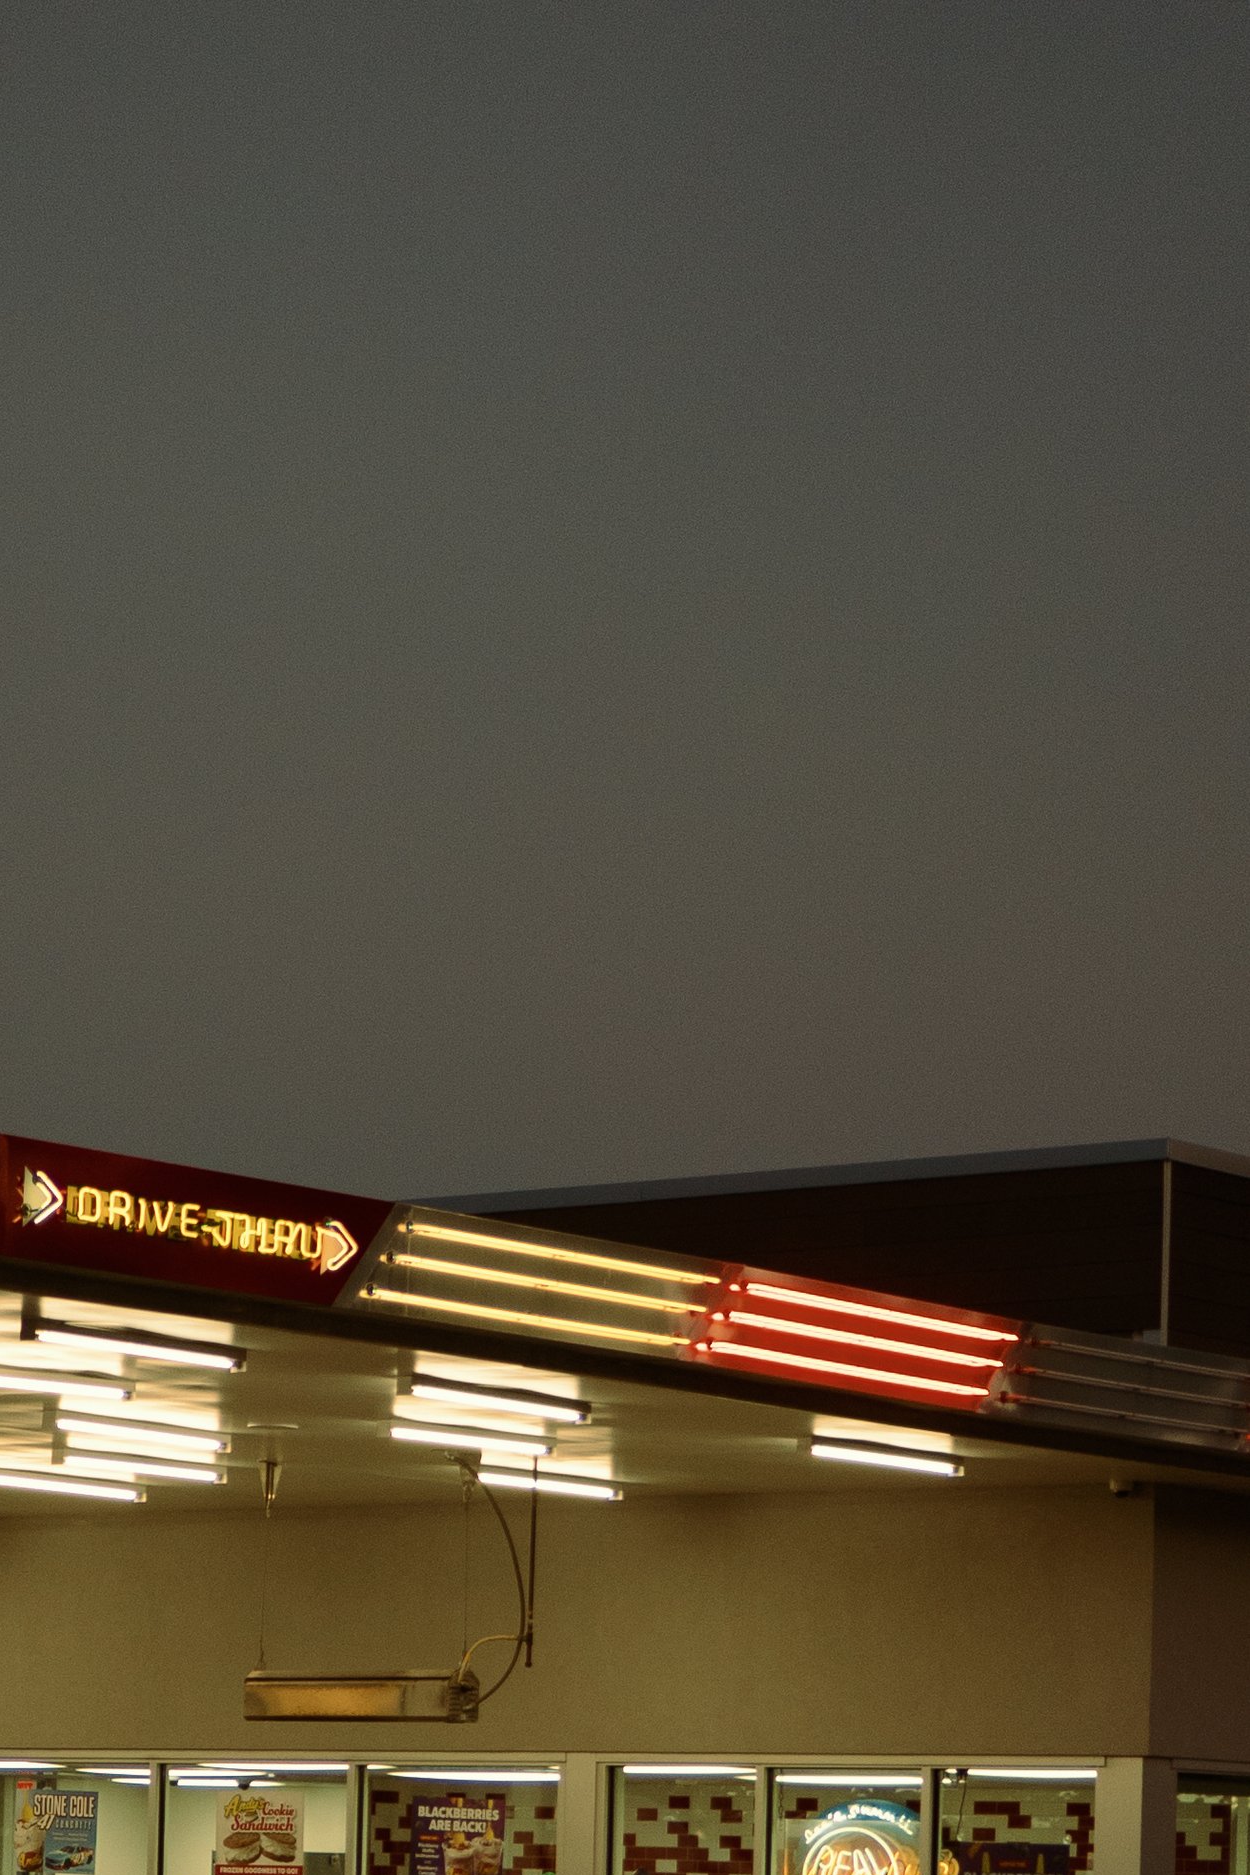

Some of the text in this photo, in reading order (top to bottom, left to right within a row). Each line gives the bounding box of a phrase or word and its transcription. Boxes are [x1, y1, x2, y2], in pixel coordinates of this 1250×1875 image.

[66, 1185, 323, 1260] DRIVE-THRU
[33, 1794, 95, 1818] STONE COLE
[262, 1801, 295, 1816] Cookie
[418, 1806, 499, 1821] BLACKBERRIES
[231, 1813, 293, 1831] Sandwich
[429, 1820, 486, 1833] ARE BACK!
